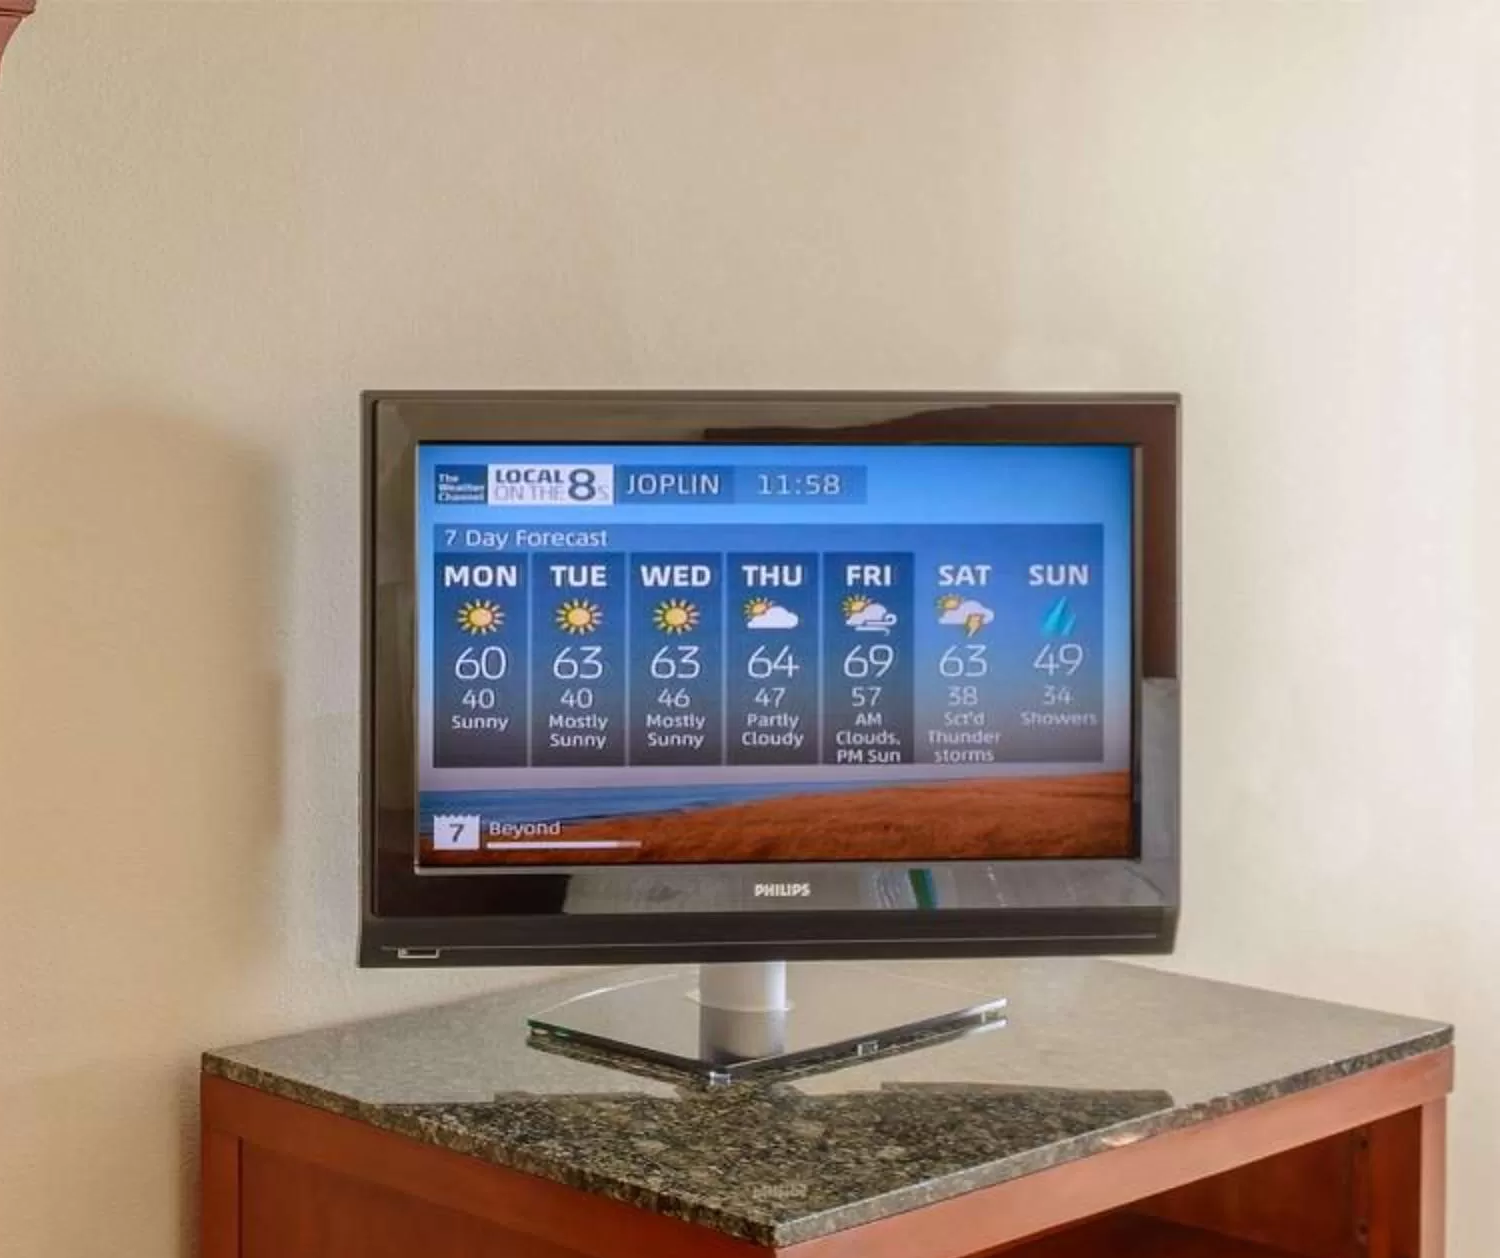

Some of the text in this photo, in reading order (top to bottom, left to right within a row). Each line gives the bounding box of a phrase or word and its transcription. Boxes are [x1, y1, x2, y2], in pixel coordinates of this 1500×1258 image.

[438, 473, 460, 483] The
[495, 469, 565, 484] LOCAL
[626, 473, 841, 495] JOPLIN 11:58
[494, 485, 525, 501] ON
[529, 485, 566, 501] THE
[444, 529, 608, 549] 7 Day Forecast
[444, 565, 518, 588] MON
[549, 565, 608, 588] TUE
[640, 565, 712, 588] WED
[741, 564, 803, 587] THU
[846, 564, 891, 587] FRI
[937, 563, 992, 586] SAT
[1028, 563, 1089, 586] SUN
[454, 645, 508, 681] 60
[553, 645, 604, 680] 63
[650, 645, 701, 680] 63
[747, 644, 800, 679] 64
[843, 644, 895, 678] 69
[939, 643, 989, 678] 63
[1032, 643, 1084, 677] 49
[461, 688, 496, 709] 40
[559, 688, 594, 709] 40
[657, 688, 691, 709] 46
[754, 686, 787, 708] 47
[851, 686, 883, 707] 57
[1043, 684, 1074, 705] 34
[451, 714, 509, 731] Sunny
[548, 714, 609, 731] Mostly
[645, 714, 706, 731] Mostly
[746, 712, 800, 730] Partly
[854, 713, 883, 727] AM
[1019, 711, 1098, 727] Showers
[549, 732, 607, 749] Sunny
[646, 732, 705, 749] Sunny
[741, 731, 805, 749] Cloudy
[927, 730, 1002, 745] Thunder
[836, 749, 902, 764] PM Sun
[933, 748, 995, 764] storms
[449, 823, 465, 843] 7
[489, 820, 563, 840] Beyond
[753, 883, 812, 898] PHILIPS
